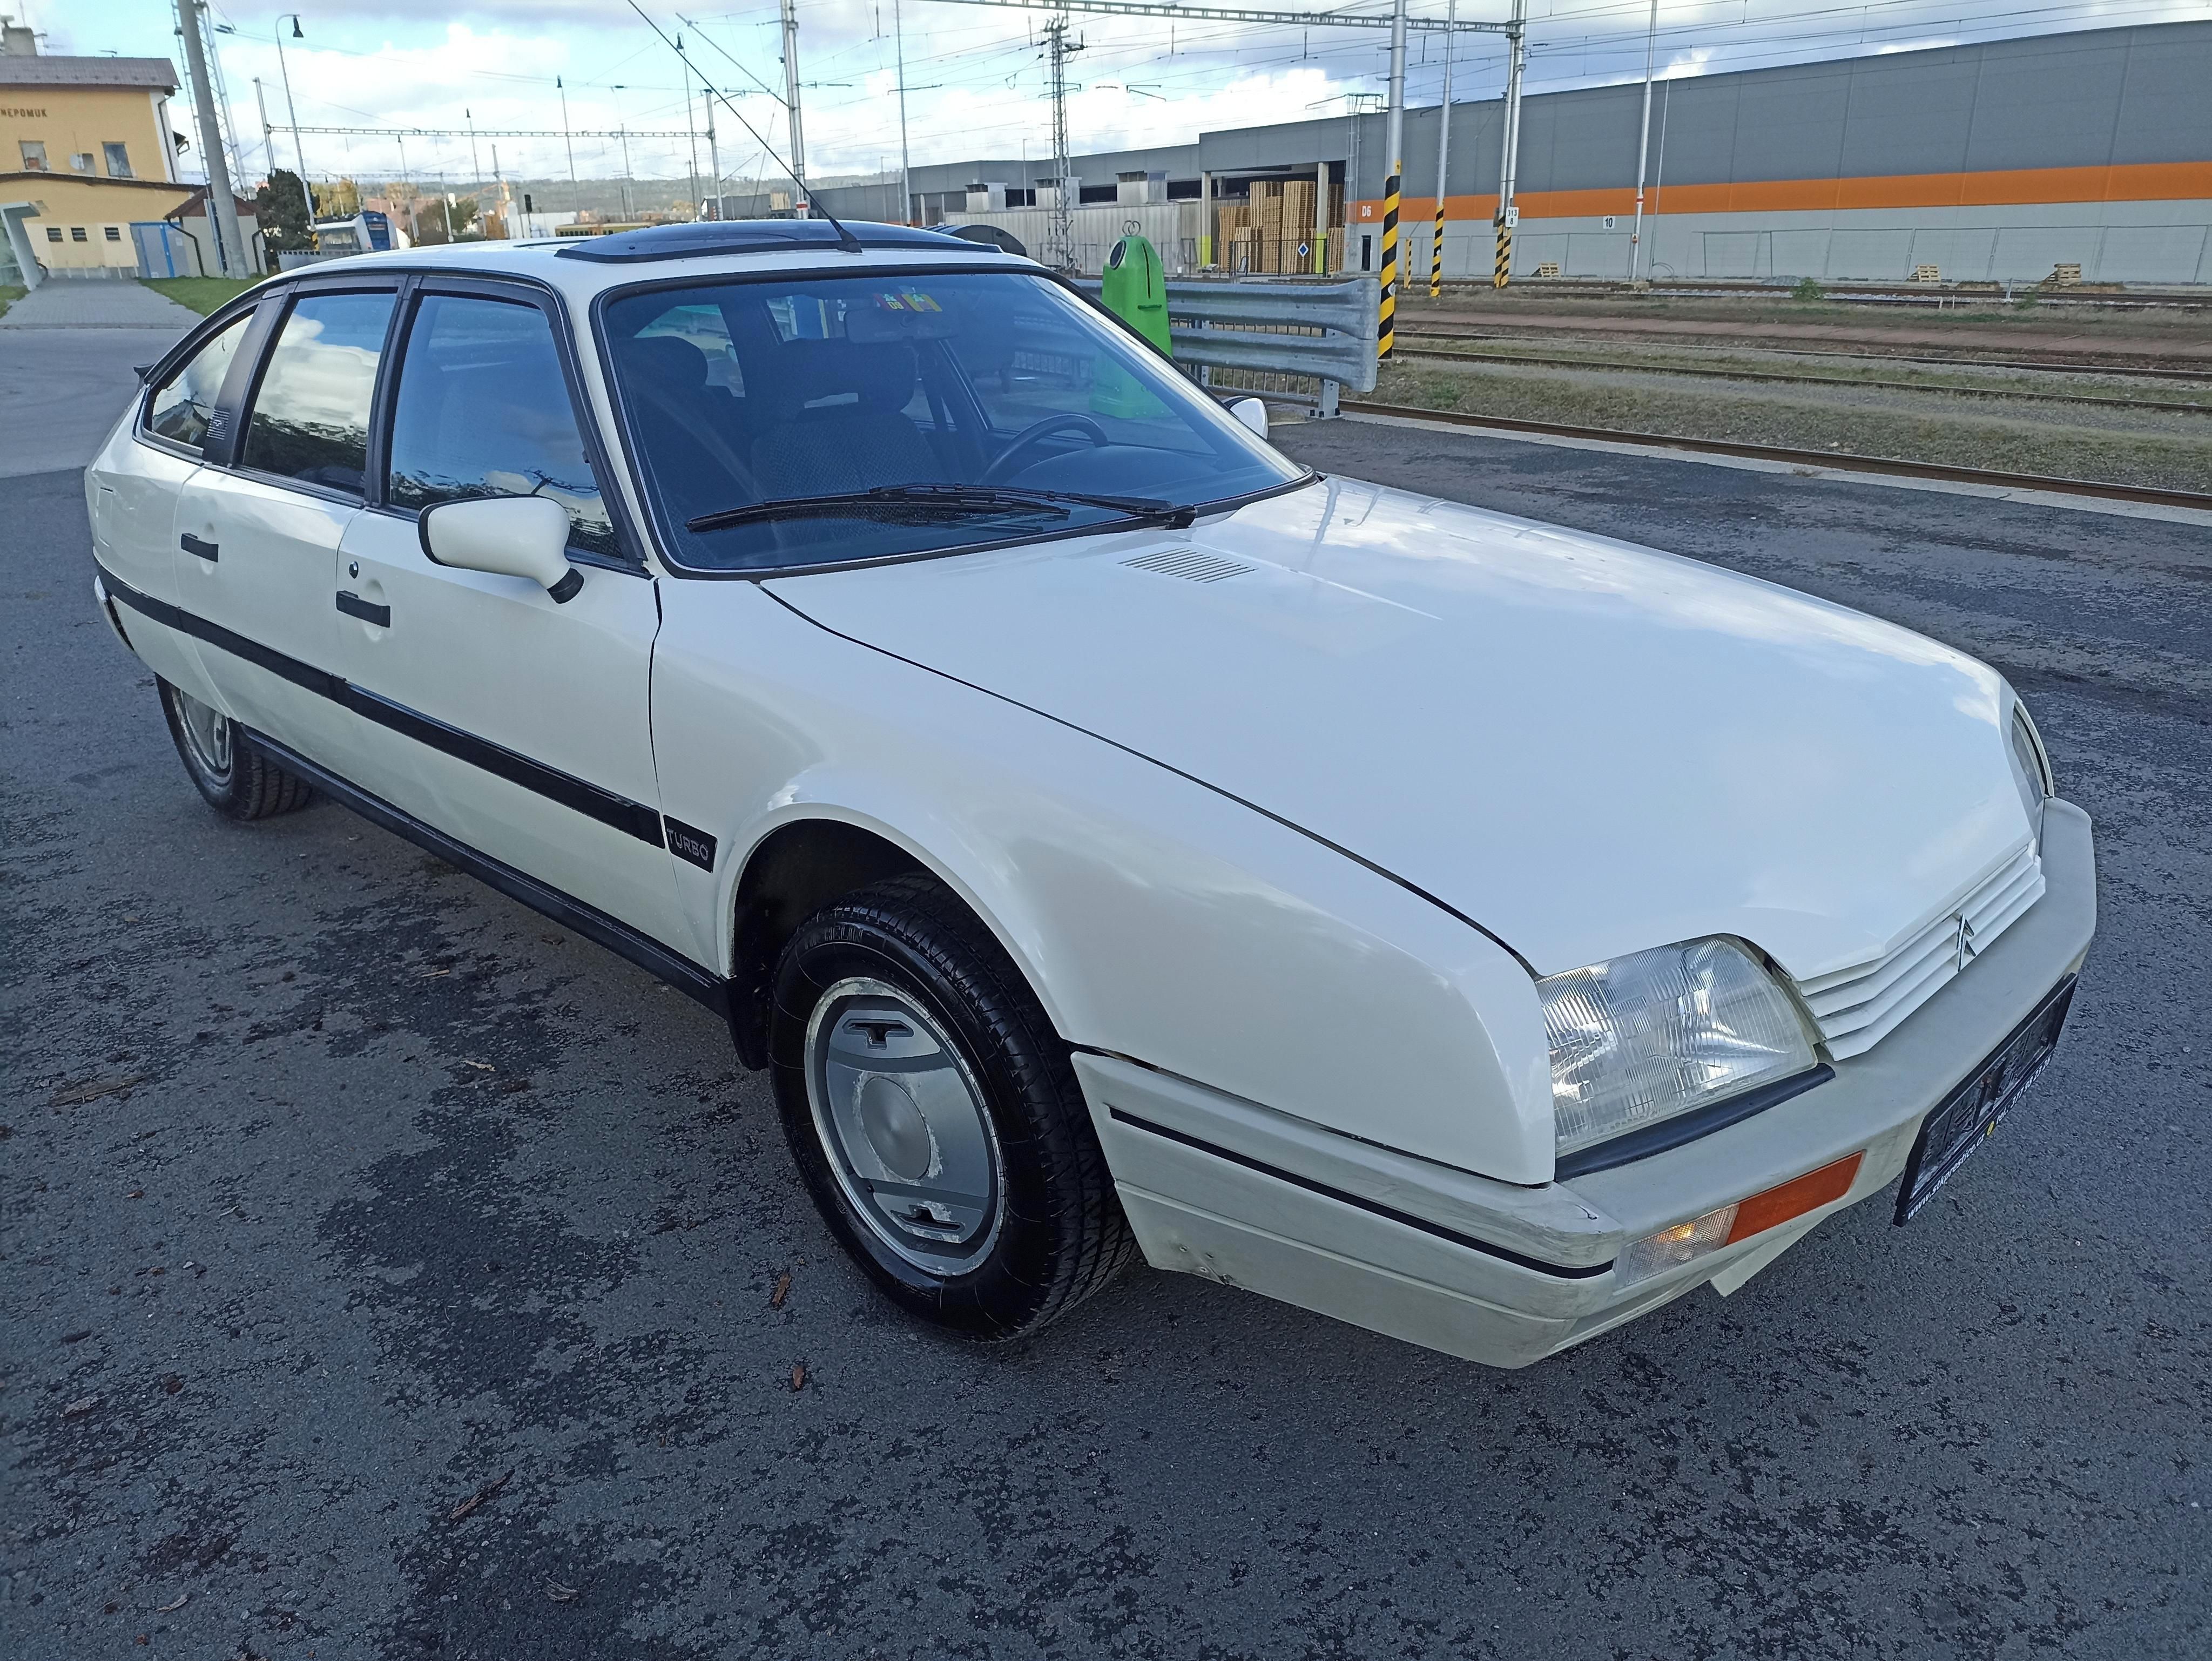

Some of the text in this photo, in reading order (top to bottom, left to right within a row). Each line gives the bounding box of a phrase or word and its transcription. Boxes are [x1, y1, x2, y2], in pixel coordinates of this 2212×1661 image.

[1, 108, 48, 117] NEPOMUK
[1362, 205, 1372, 217] D6
[1605, 217, 1613, 228] 10
[666, 828, 709, 861] TURBO
[2010, 1086, 2025, 1109] 377
